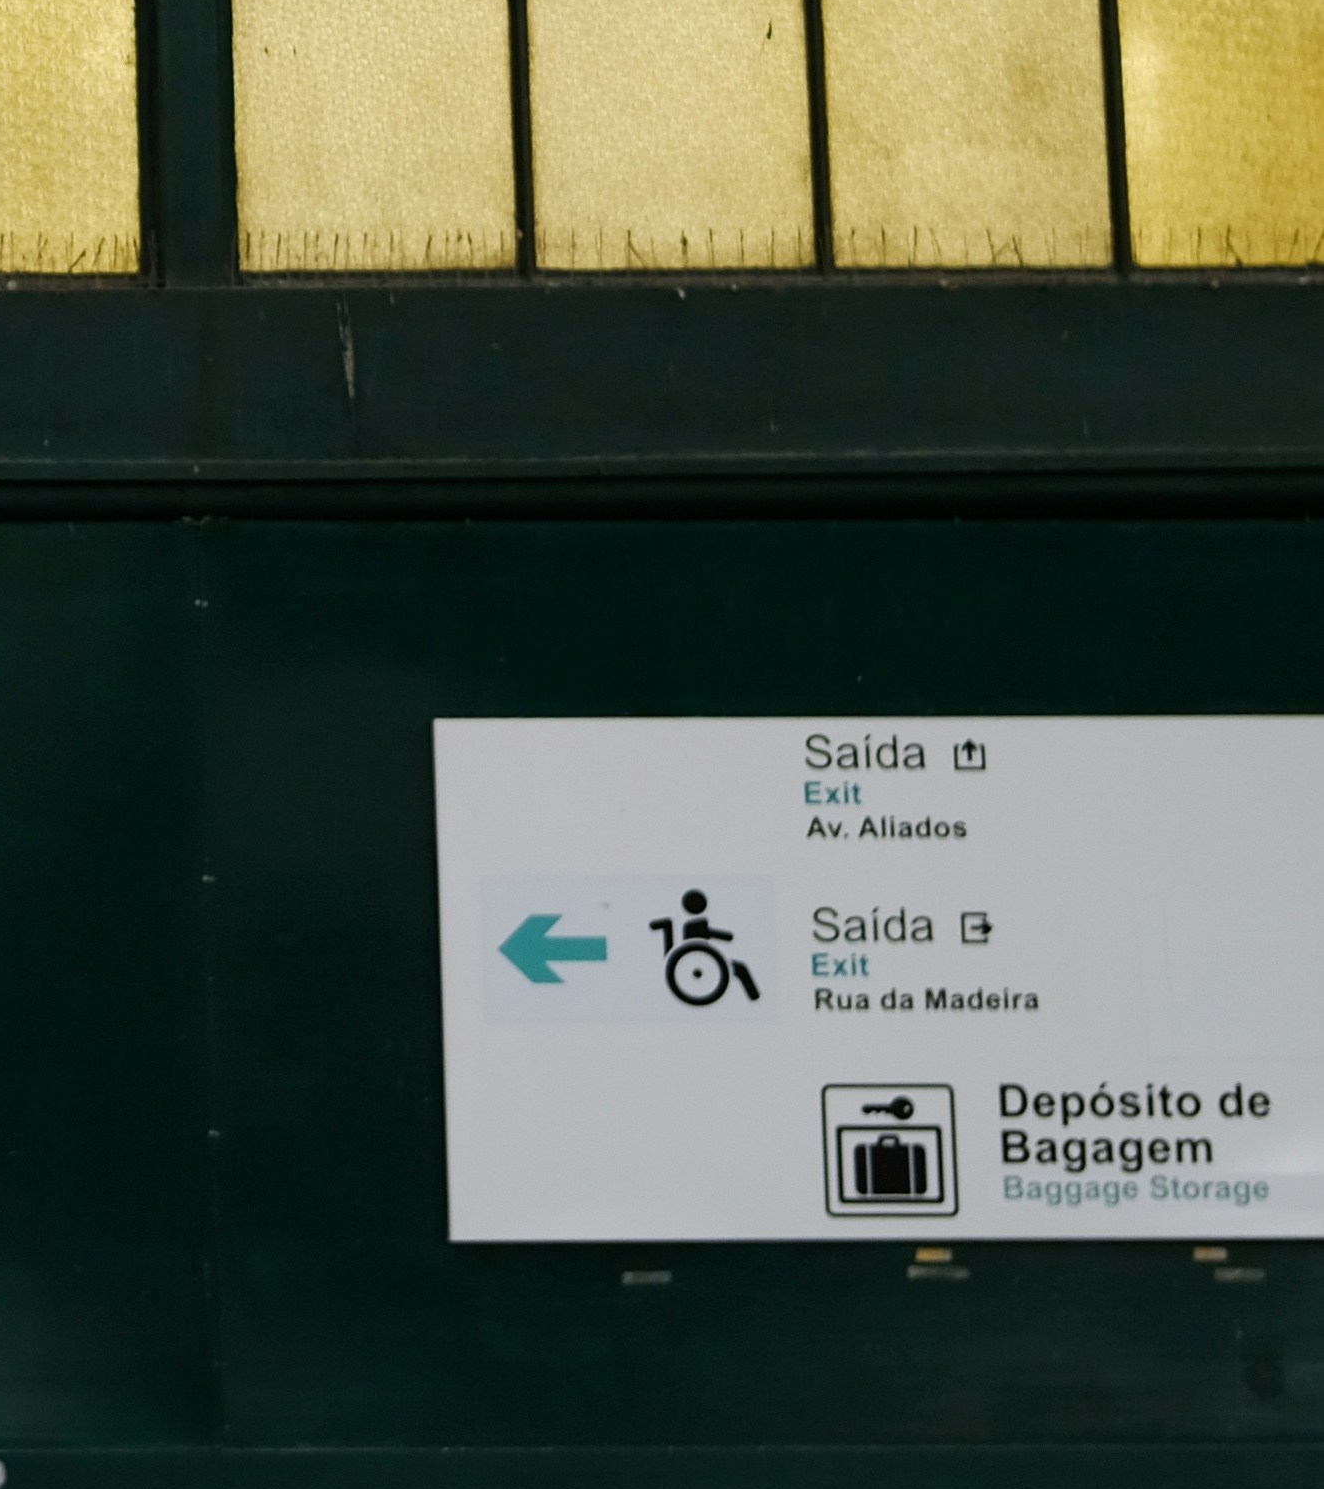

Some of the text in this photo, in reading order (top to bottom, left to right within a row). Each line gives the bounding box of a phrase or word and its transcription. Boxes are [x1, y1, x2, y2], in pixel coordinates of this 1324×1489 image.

[806, 734, 925, 770] Saída
[804, 781, 861, 805] Exit
[807, 816, 967, 838] Av. Aliados
[813, 907, 934, 943] Saída
[812, 953, 869, 977] Exit
[815, 988, 1038, 1011] Rua da Madeira
[999, 1083, 1270, 1126] Depósito de
[1001, 1130, 1212, 1173] Bagagem
[1003, 1174, 1269, 1207] Baggage Storage
